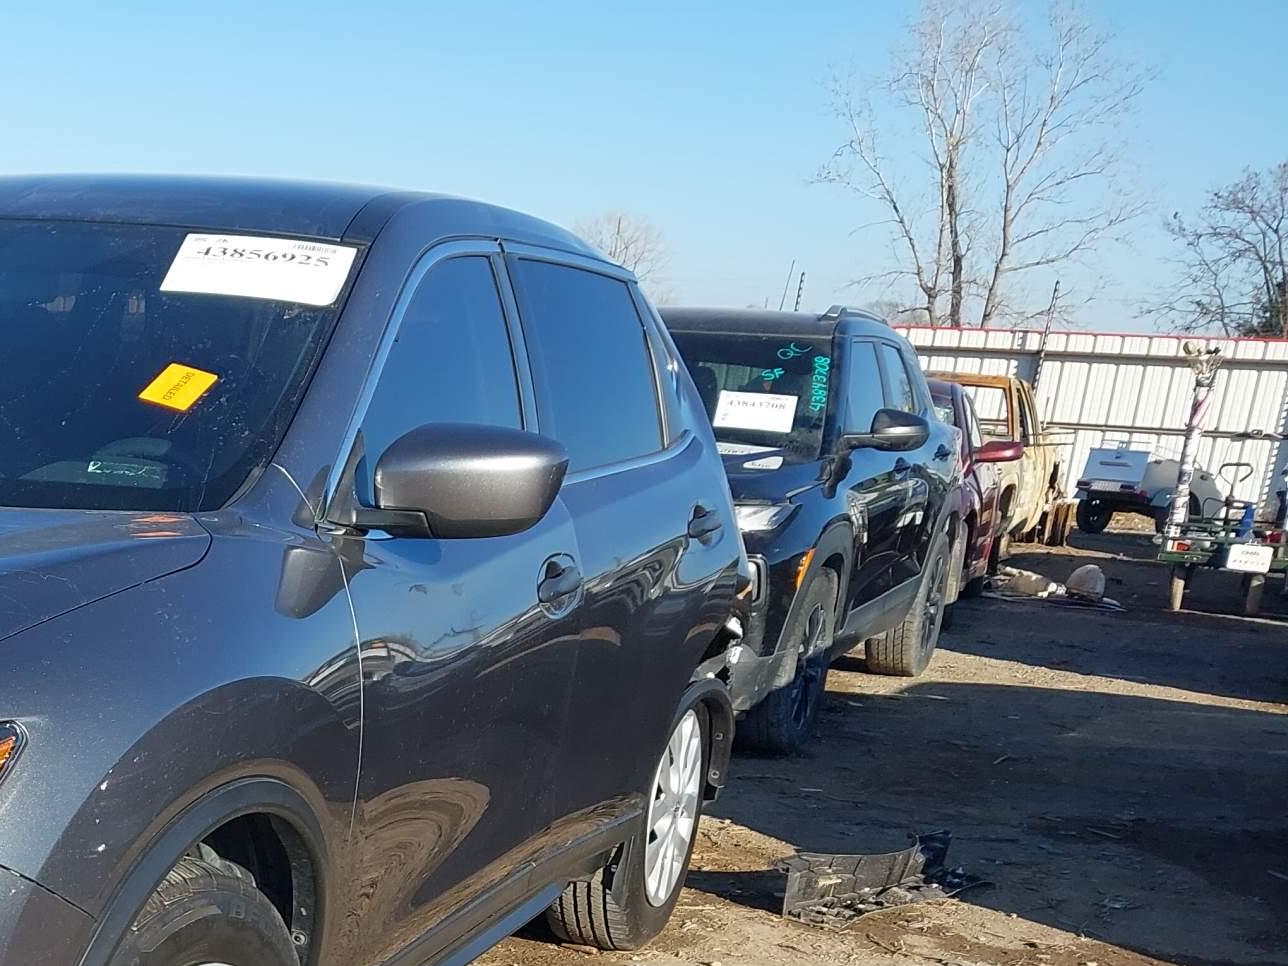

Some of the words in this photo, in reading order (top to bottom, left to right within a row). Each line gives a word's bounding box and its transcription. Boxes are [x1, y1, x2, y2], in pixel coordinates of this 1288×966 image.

[196, 245, 331, 268] 43856925
[162, 371, 196, 401] DETAILED
[761, 367, 785, 381] SF
[808, 355, 831, 412] 43843708
